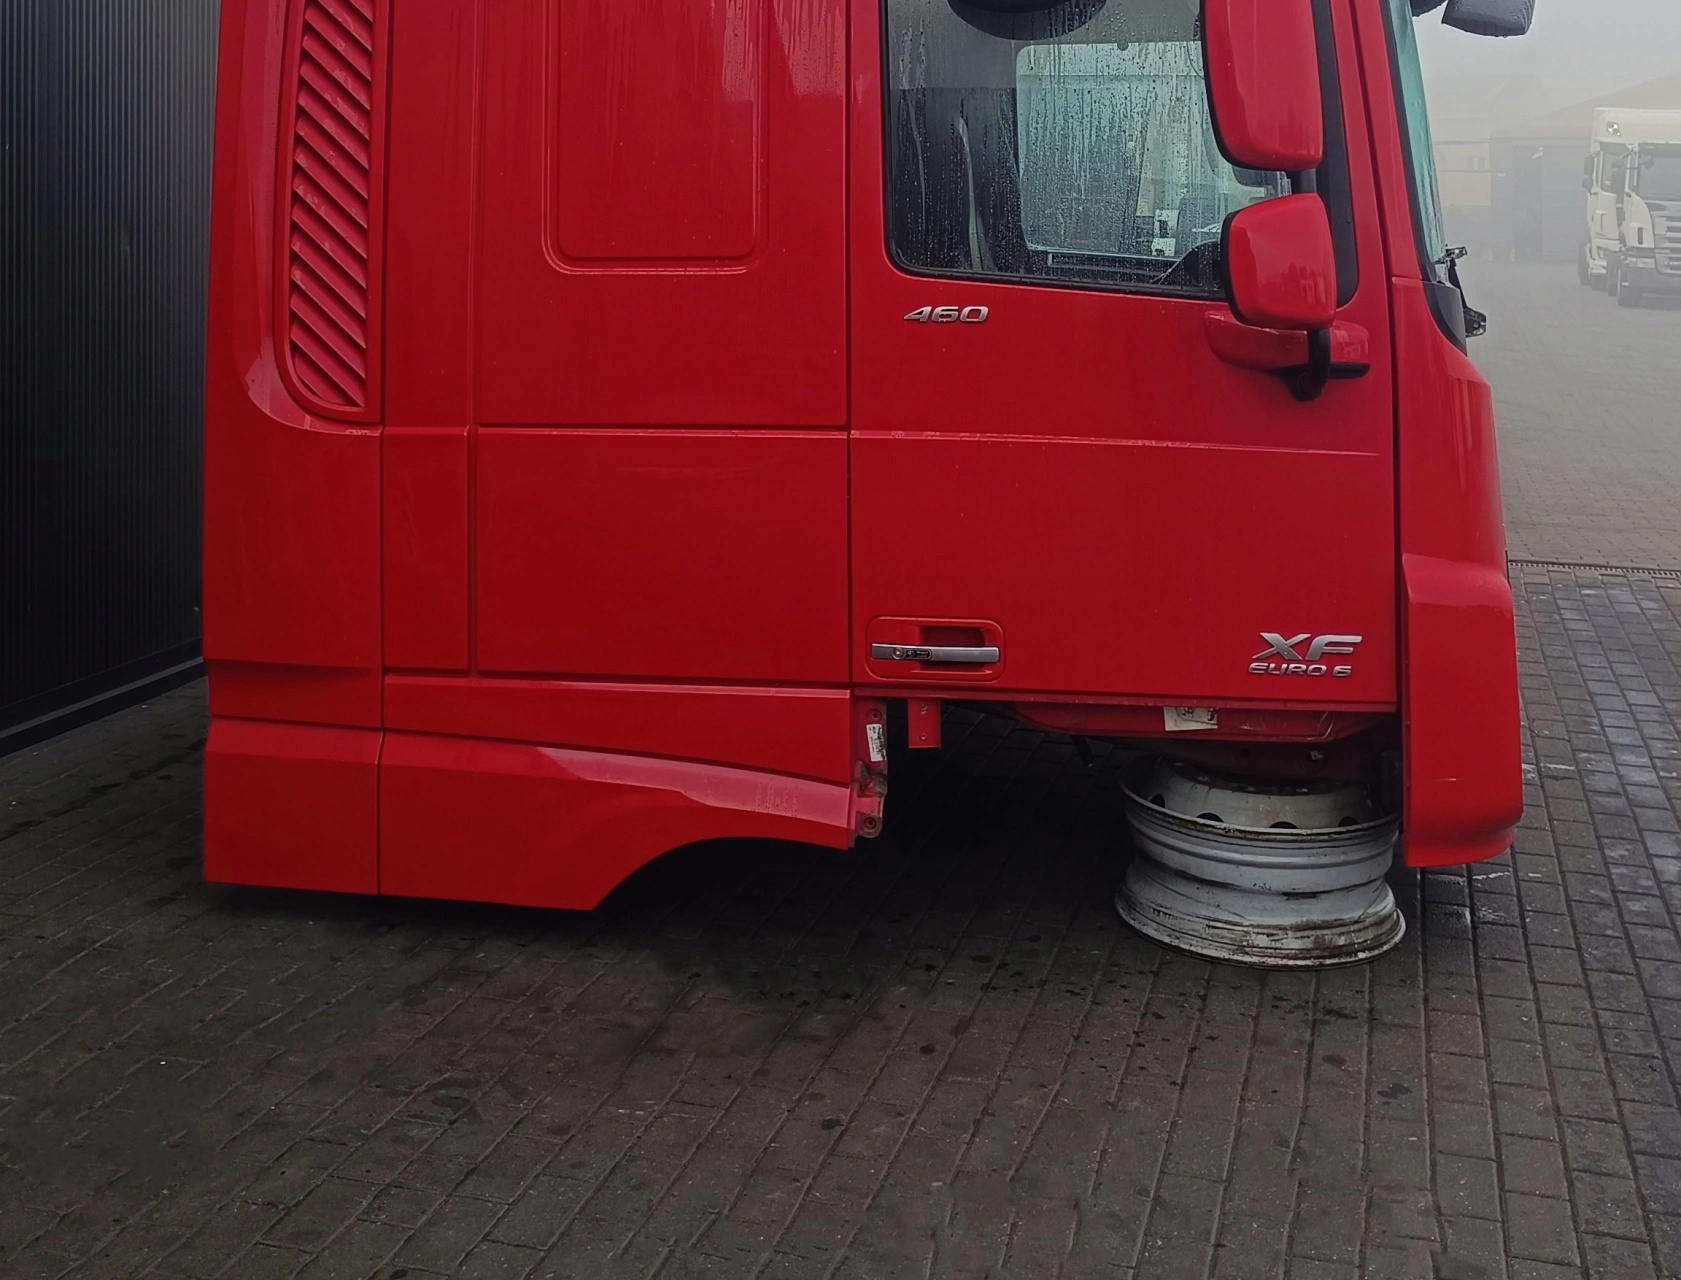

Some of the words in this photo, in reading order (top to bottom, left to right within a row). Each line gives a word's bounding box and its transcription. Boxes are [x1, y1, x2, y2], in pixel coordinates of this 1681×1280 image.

[903, 306, 989, 322] 460
[1252, 632, 1363, 661] XF
[1248, 662, 1327, 676] EURO
[1332, 665, 1352, 677] 6
